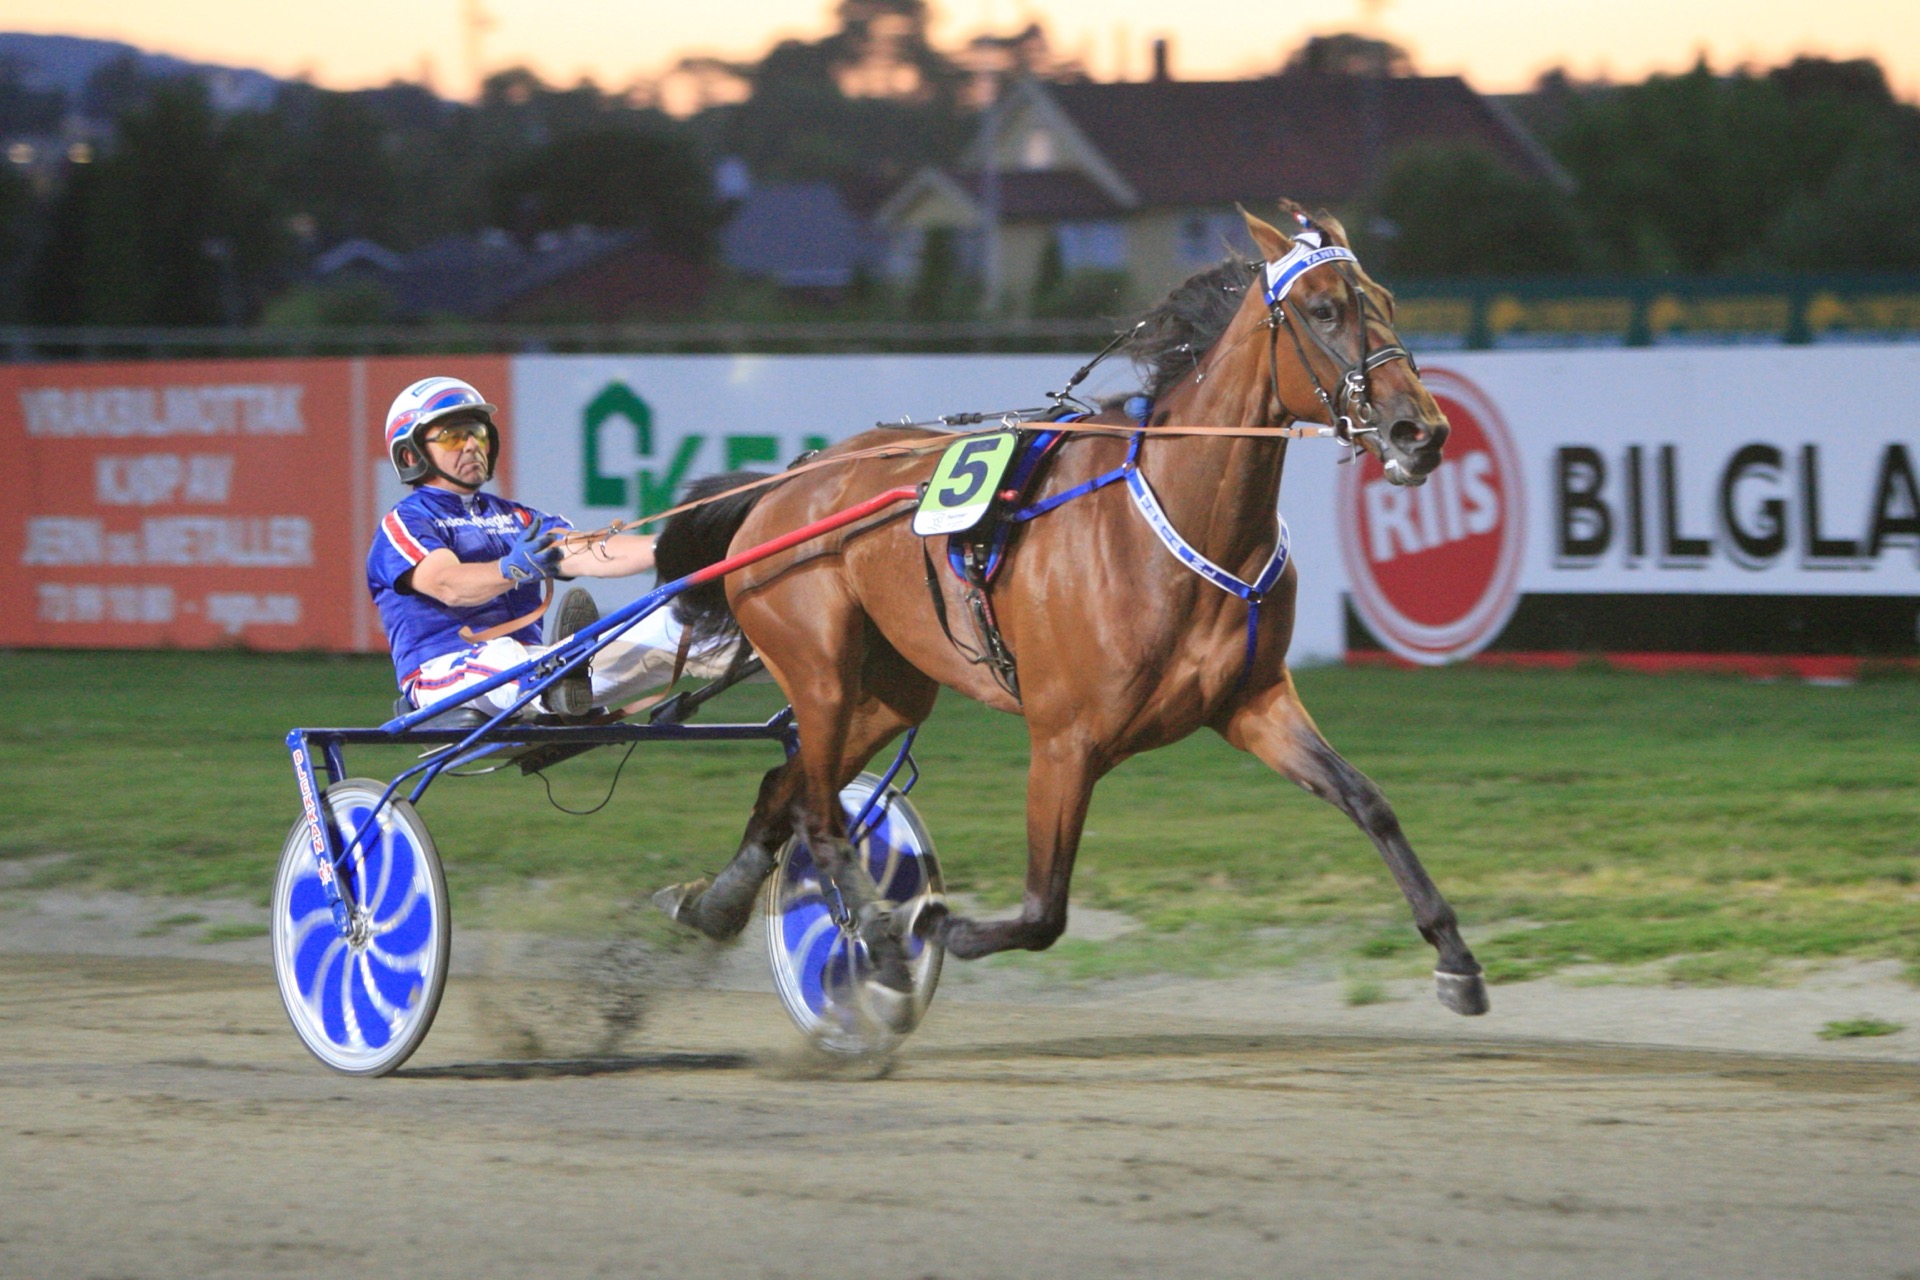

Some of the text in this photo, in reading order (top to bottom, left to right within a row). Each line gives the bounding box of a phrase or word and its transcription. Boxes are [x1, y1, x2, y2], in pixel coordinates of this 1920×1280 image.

[1302, 248, 1345, 266] TANIA
[938, 437, 1002, 508] 5
[1366, 449, 1499, 563] RIIS
[1554, 443, 1920, 564] BILGLA
[292, 748, 325, 855] BLEKKAN
